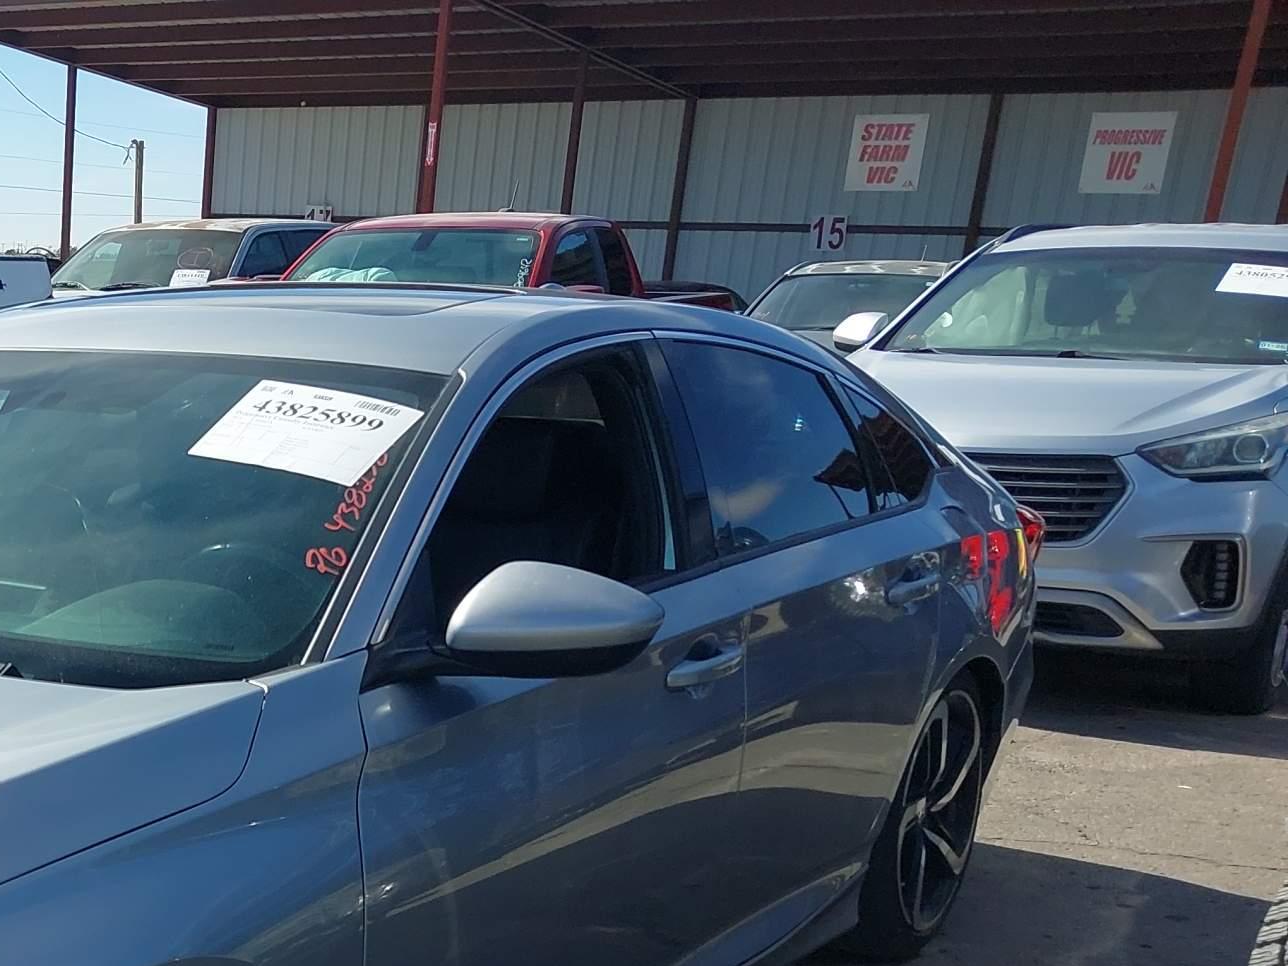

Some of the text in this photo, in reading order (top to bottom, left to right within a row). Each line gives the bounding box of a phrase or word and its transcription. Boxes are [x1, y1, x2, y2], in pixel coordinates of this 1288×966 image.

[861, 123, 915, 141] STATE
[1092, 128, 1167, 145] PROGRESSIVE
[859, 144, 910, 162] FARM
[1105, 150, 1142, 181] VIC
[866, 166, 899, 185] VIC
[813, 216, 845, 250] 15
[253, 398, 385, 432] 43825899
